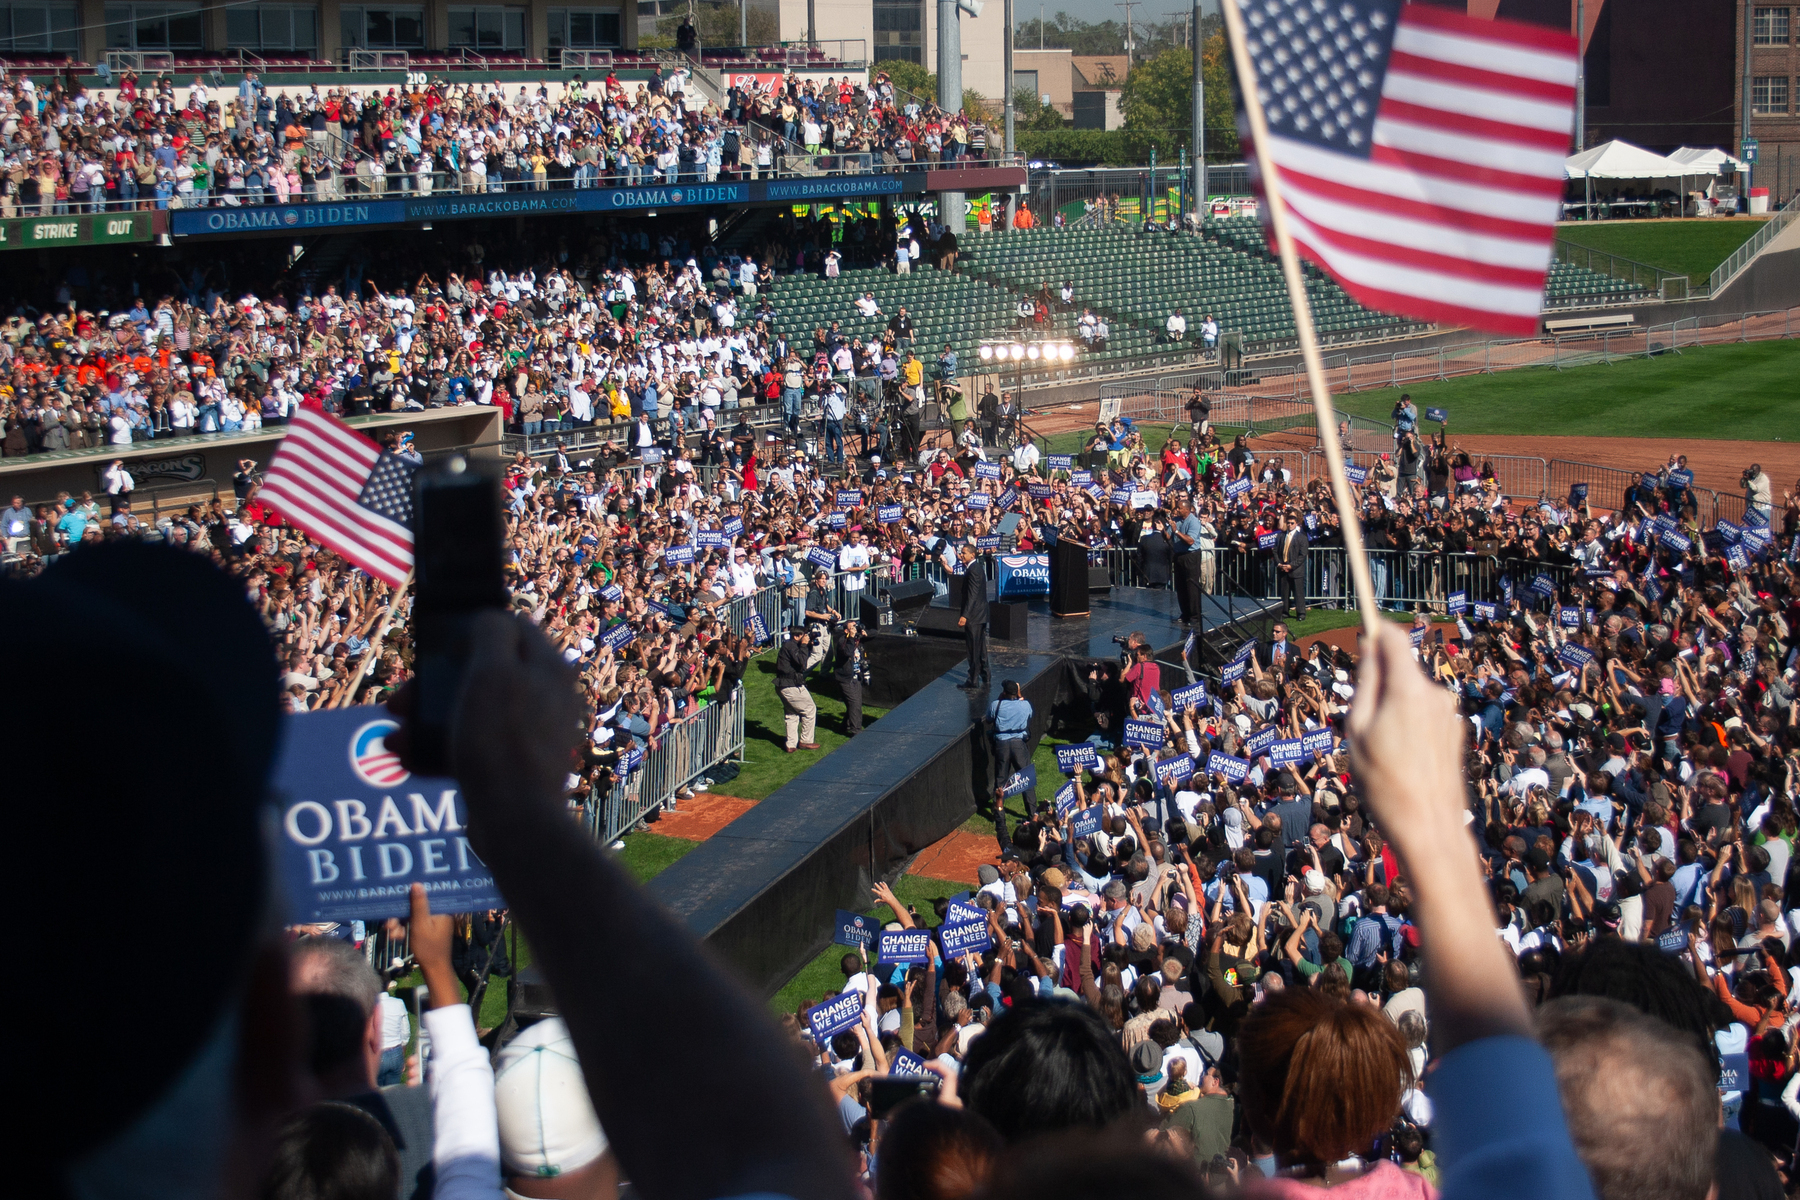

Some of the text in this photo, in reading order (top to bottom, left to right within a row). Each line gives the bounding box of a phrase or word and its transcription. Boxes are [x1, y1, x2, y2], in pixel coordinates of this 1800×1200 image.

[406, 72, 427, 84] 210
[735, 74, 776, 94] Bud
[769, 180, 903, 196] WWW.BARACKOBAMA.COM
[612, 187, 738, 207] OBAMA BIDEN
[410, 197, 577, 217] WWW.BARACKOBAMA.COM
[208, 206, 369, 230] OBAMA BIDEN
[34, 223, 78, 240] STRIKE
[108, 220, 132, 235] OUT
[1344, 466, 1366, 476] CHANGE
[1226, 478, 1248, 490] CHANGE
[1748, 508, 1766, 525] CHANGE
[724, 518, 741, 530] CHANGE
[1664, 530, 1690, 546] CHANGE
[666, 547, 692, 556] CHANGE
[812, 546, 836, 560] CHANGE
[820, 554, 834, 564] NEED
[1449, 594, 1465, 603] CHANGE
[1562, 610, 1592, 619] CHAE
[604, 624, 628, 642] CHANGE
[755, 616, 768, 640] CHANGE
[616, 630, 630, 642] NEED
[1565, 645, 1591, 659] CHANGE
[1572, 654, 1586, 663] NEED
[1224, 661, 1245, 674] CHANGE
[1233, 667, 1245, 677] NEED
[1173, 684, 1204, 701] CHANGE
[1185, 692, 1204, 703] NEED
[1126, 724, 1162, 736] CHANGE
[1140, 733, 1160, 742] NEED
[1247, 730, 1275, 747] CHANGE
[1257, 736, 1274, 747] NEED
[1303, 731, 1331, 744] CHANGE
[1315, 739, 1331, 748] NEED
[1058, 747, 1094, 758] CHANGE
[1271, 742, 1301, 753] CHANGE
[1074, 754, 1095, 763] NEED
[1211, 754, 1247, 772] CHANGE
[1157, 757, 1190, 774] CHANGE
[1172, 765, 1190, 776] NEED
[1210, 762, 1245, 778] WE NEED
[1056, 784, 1073, 804] CHANGE
[1063, 792, 1074, 804] NEED
[284, 790, 468, 845] OBAM
[1074, 817, 1096, 828] OBAMA
[1076, 823, 1095, 834] BIDEN
[318, 877, 494, 900] WWW.BARACKBAMA.COM
[950, 912, 962, 922] WE
[844, 925, 872, 938] OBAMA
[942, 922, 985, 939] CHANGE
[846, 934, 870, 944] BIDEN
[882, 935, 928, 944] CHANGE
[944, 938, 961, 948] WE
[964, 931, 986, 943] NEED
[882, 944, 926, 953] WE NEED
[813, 994, 858, 1022] CHANGE
[815, 1017, 832, 1030] WE
[834, 1004, 860, 1022] NEED
